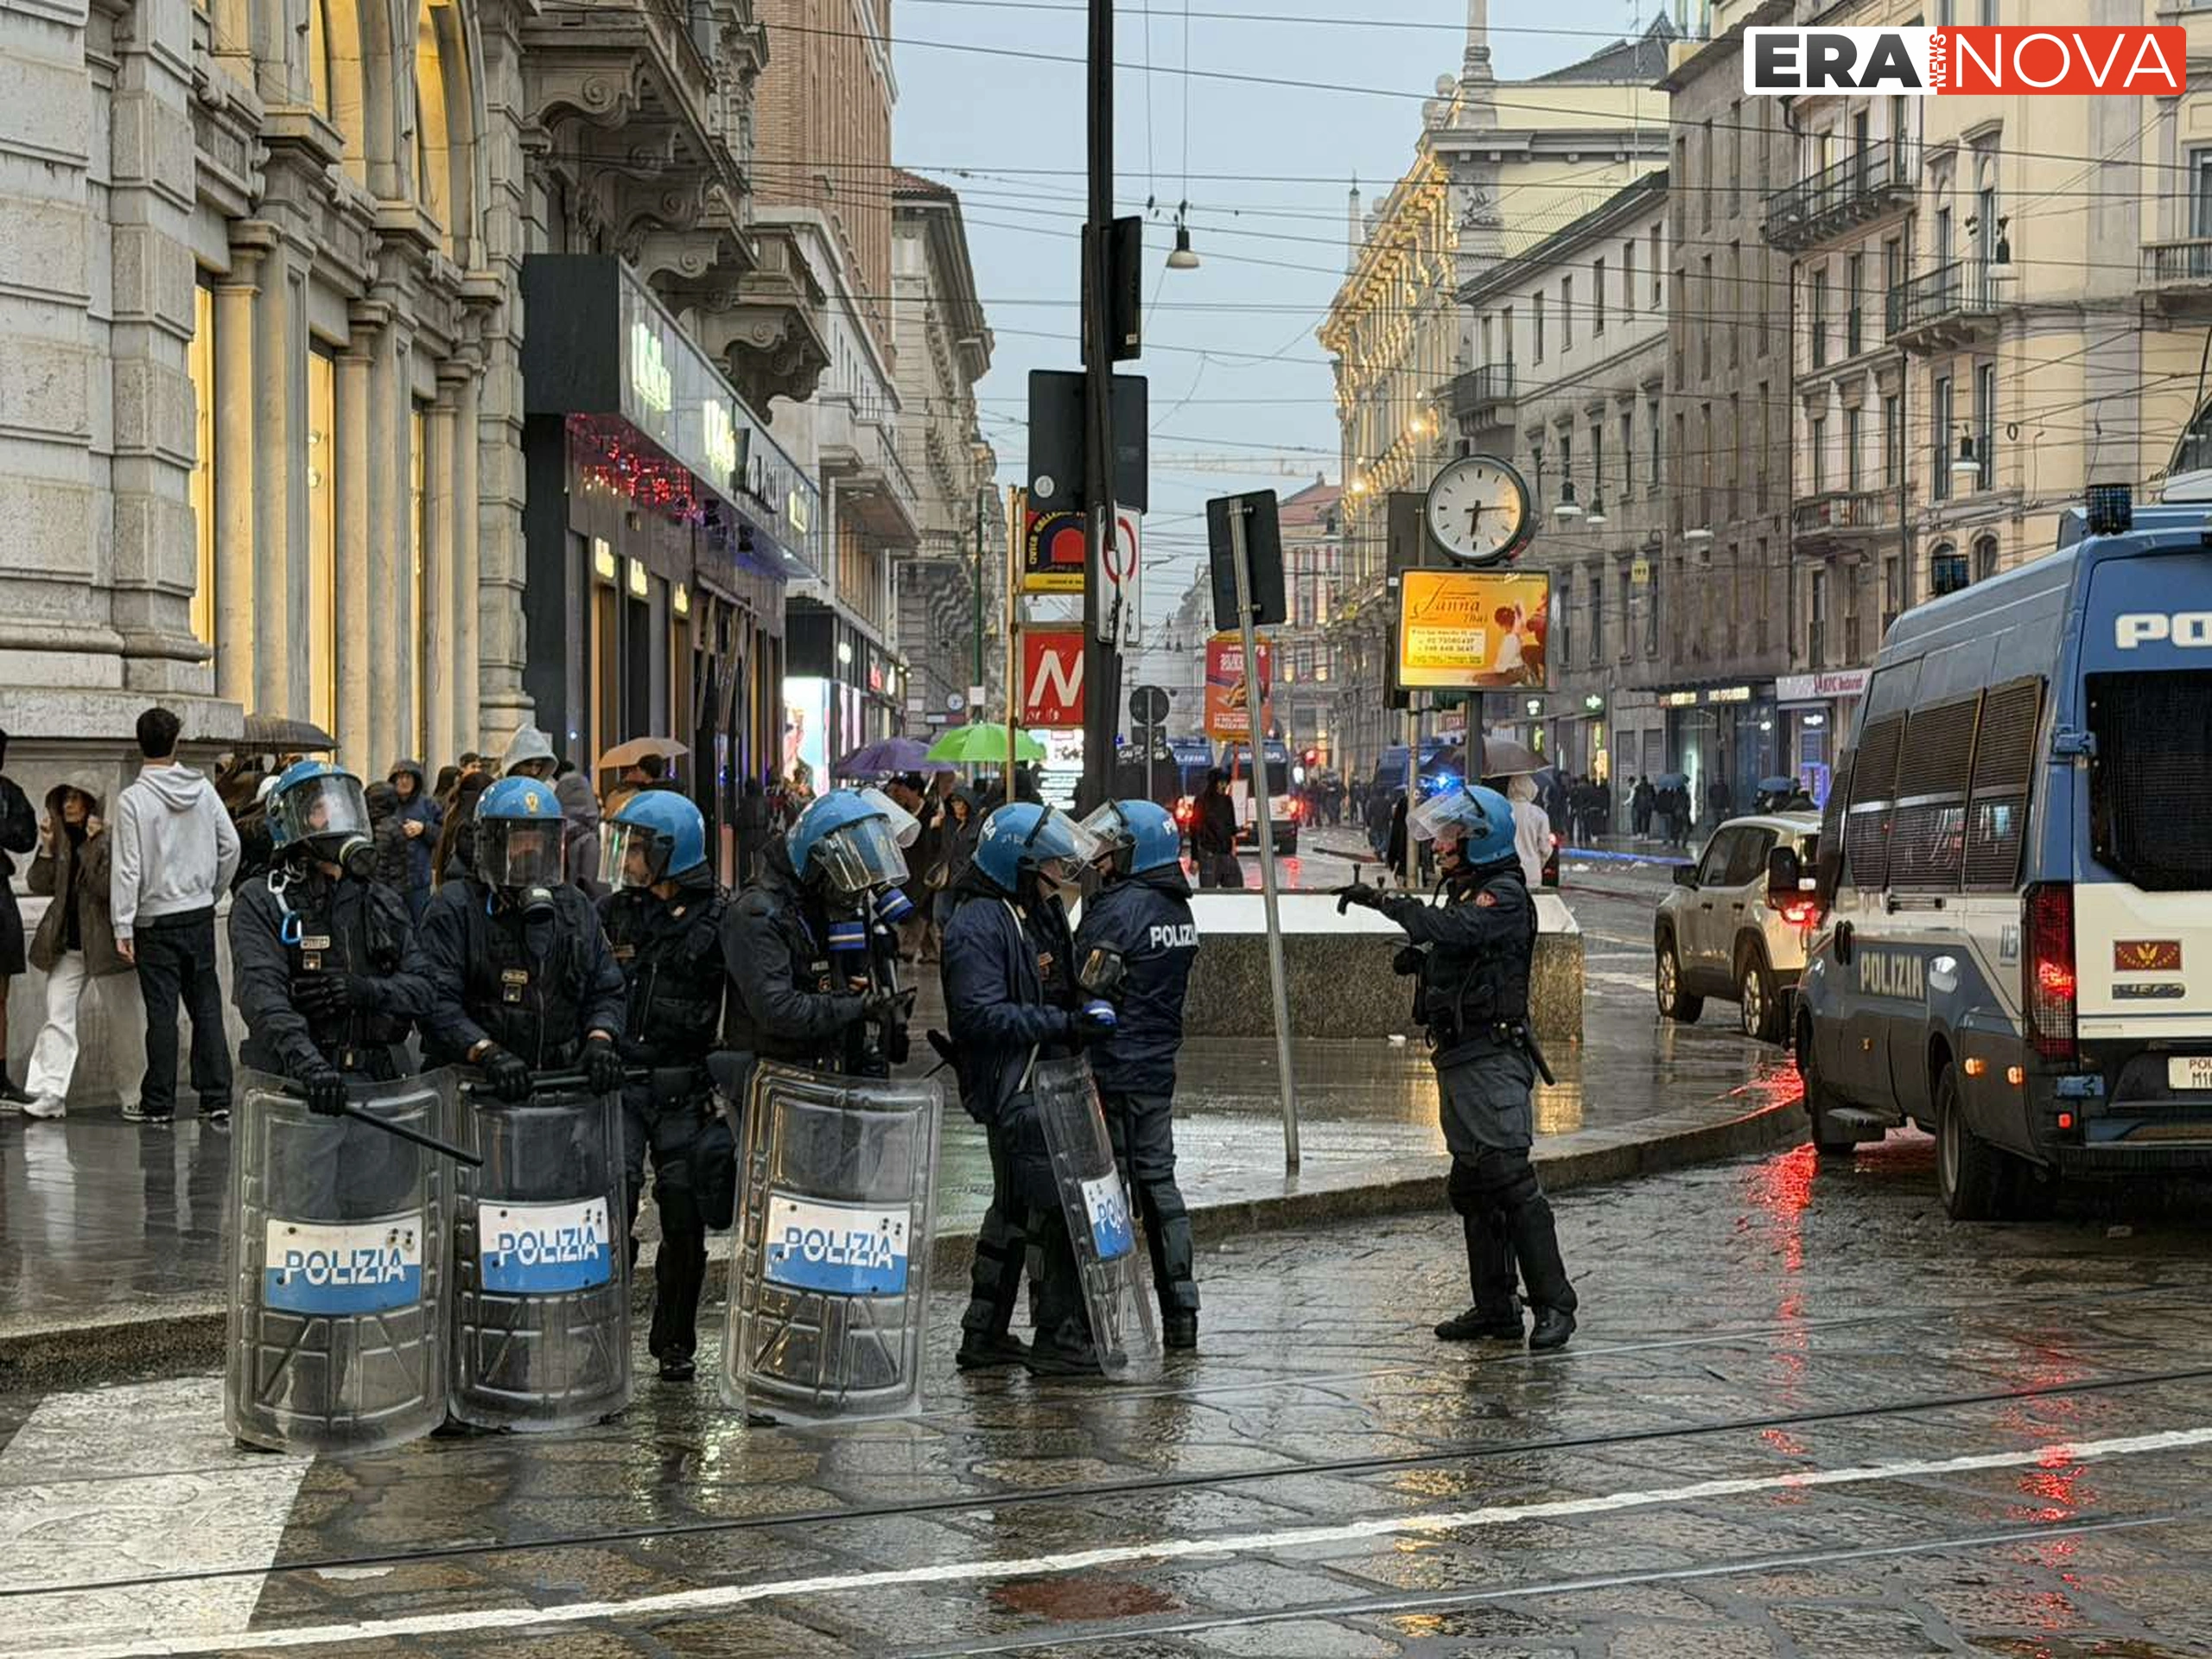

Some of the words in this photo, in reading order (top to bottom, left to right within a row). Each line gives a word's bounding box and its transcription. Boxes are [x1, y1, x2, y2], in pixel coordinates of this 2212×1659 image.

[1028, 650, 1084, 707] M
[1860, 951, 1924, 1000] POLIZIA
[283, 1249, 405, 1286] POLIZIA
[497, 1225, 599, 1268] POLIZIA
[782, 1225, 893, 1270] POLIZIA
